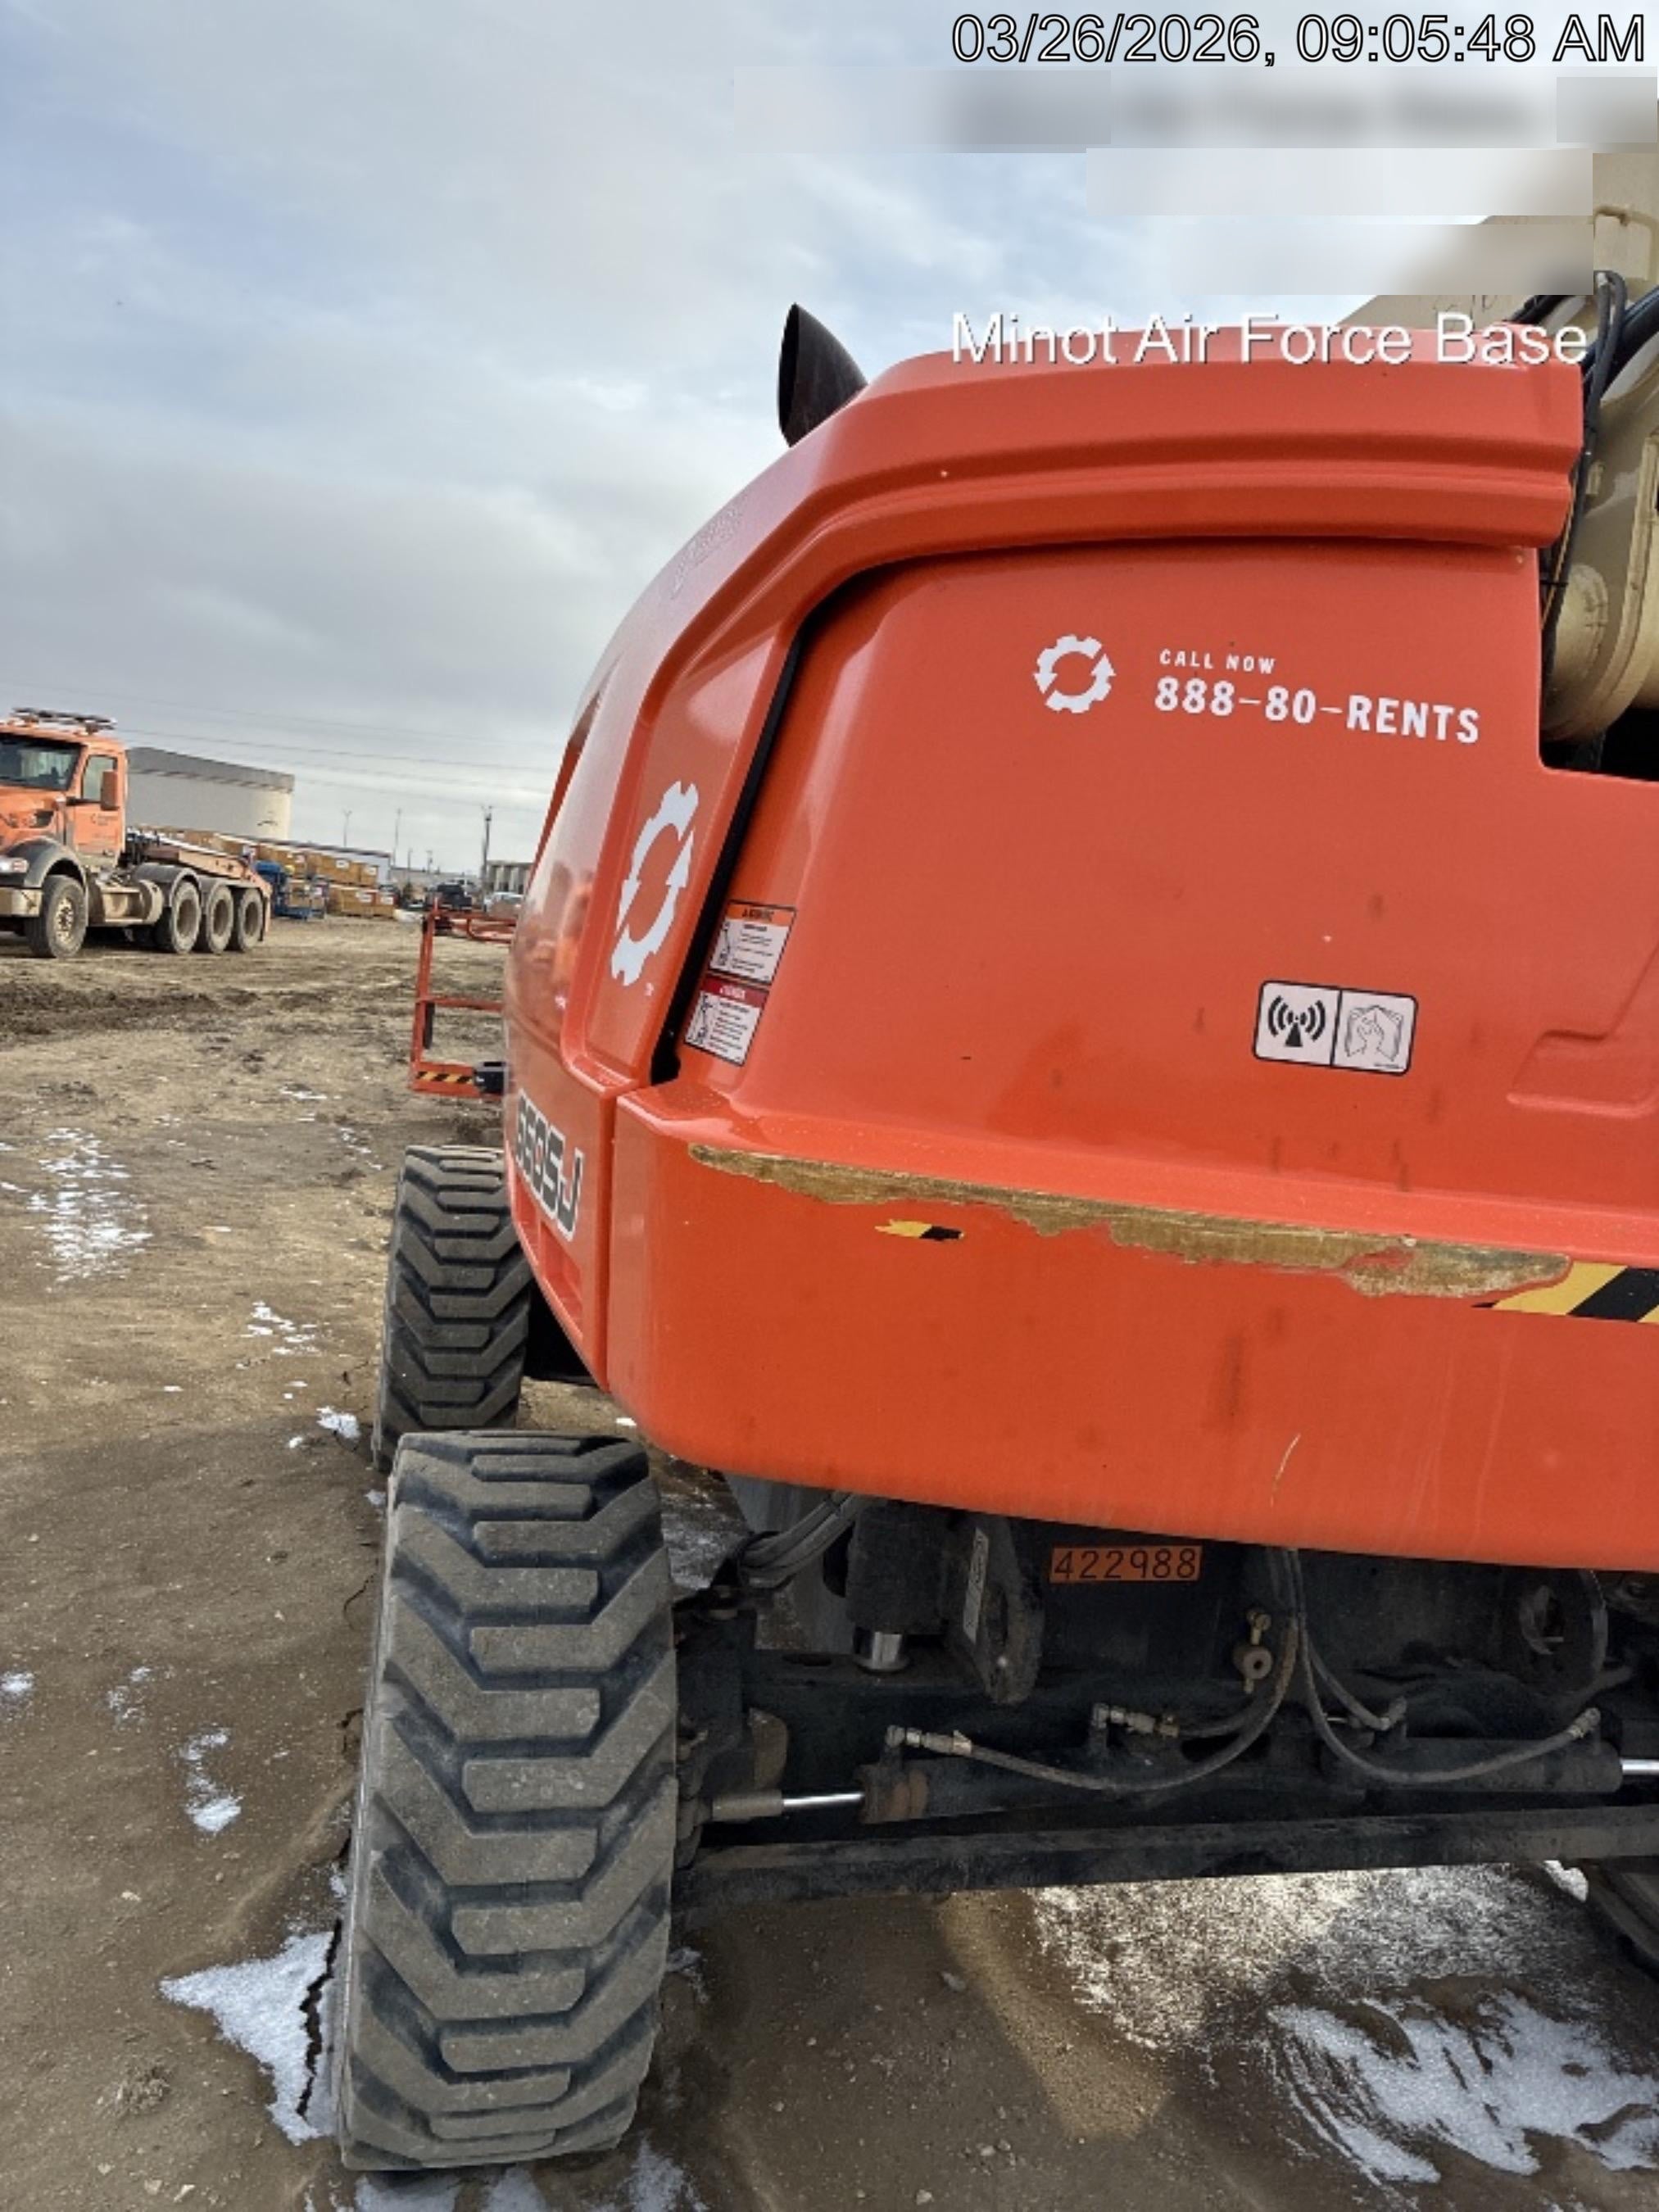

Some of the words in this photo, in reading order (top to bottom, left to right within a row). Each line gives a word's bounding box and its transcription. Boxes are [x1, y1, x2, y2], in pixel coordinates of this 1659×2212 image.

[1159, 649, 1213, 669] CALL
[1226, 655, 1276, 674] NOW
[1154, 676, 1480, 744] 888-80-RENTS
[1054, 1548, 1196, 1580] 422988
